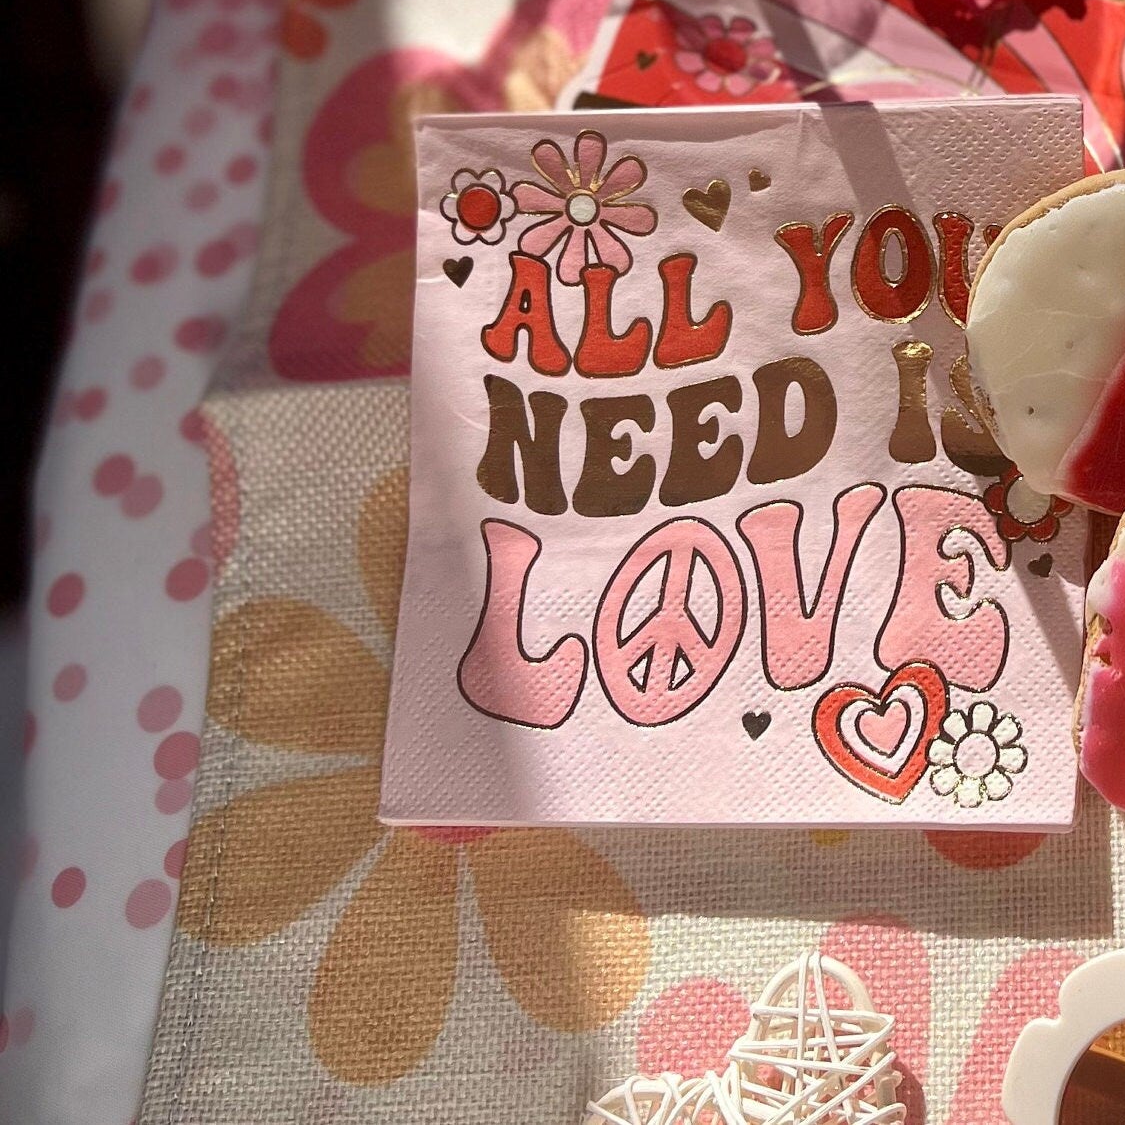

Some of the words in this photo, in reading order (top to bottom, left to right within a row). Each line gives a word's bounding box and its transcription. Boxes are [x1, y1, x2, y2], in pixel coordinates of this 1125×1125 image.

[481, 252, 733, 378] ALL
[476, 356, 838, 517] NEED
[456, 482, 1010, 730] LOVE
